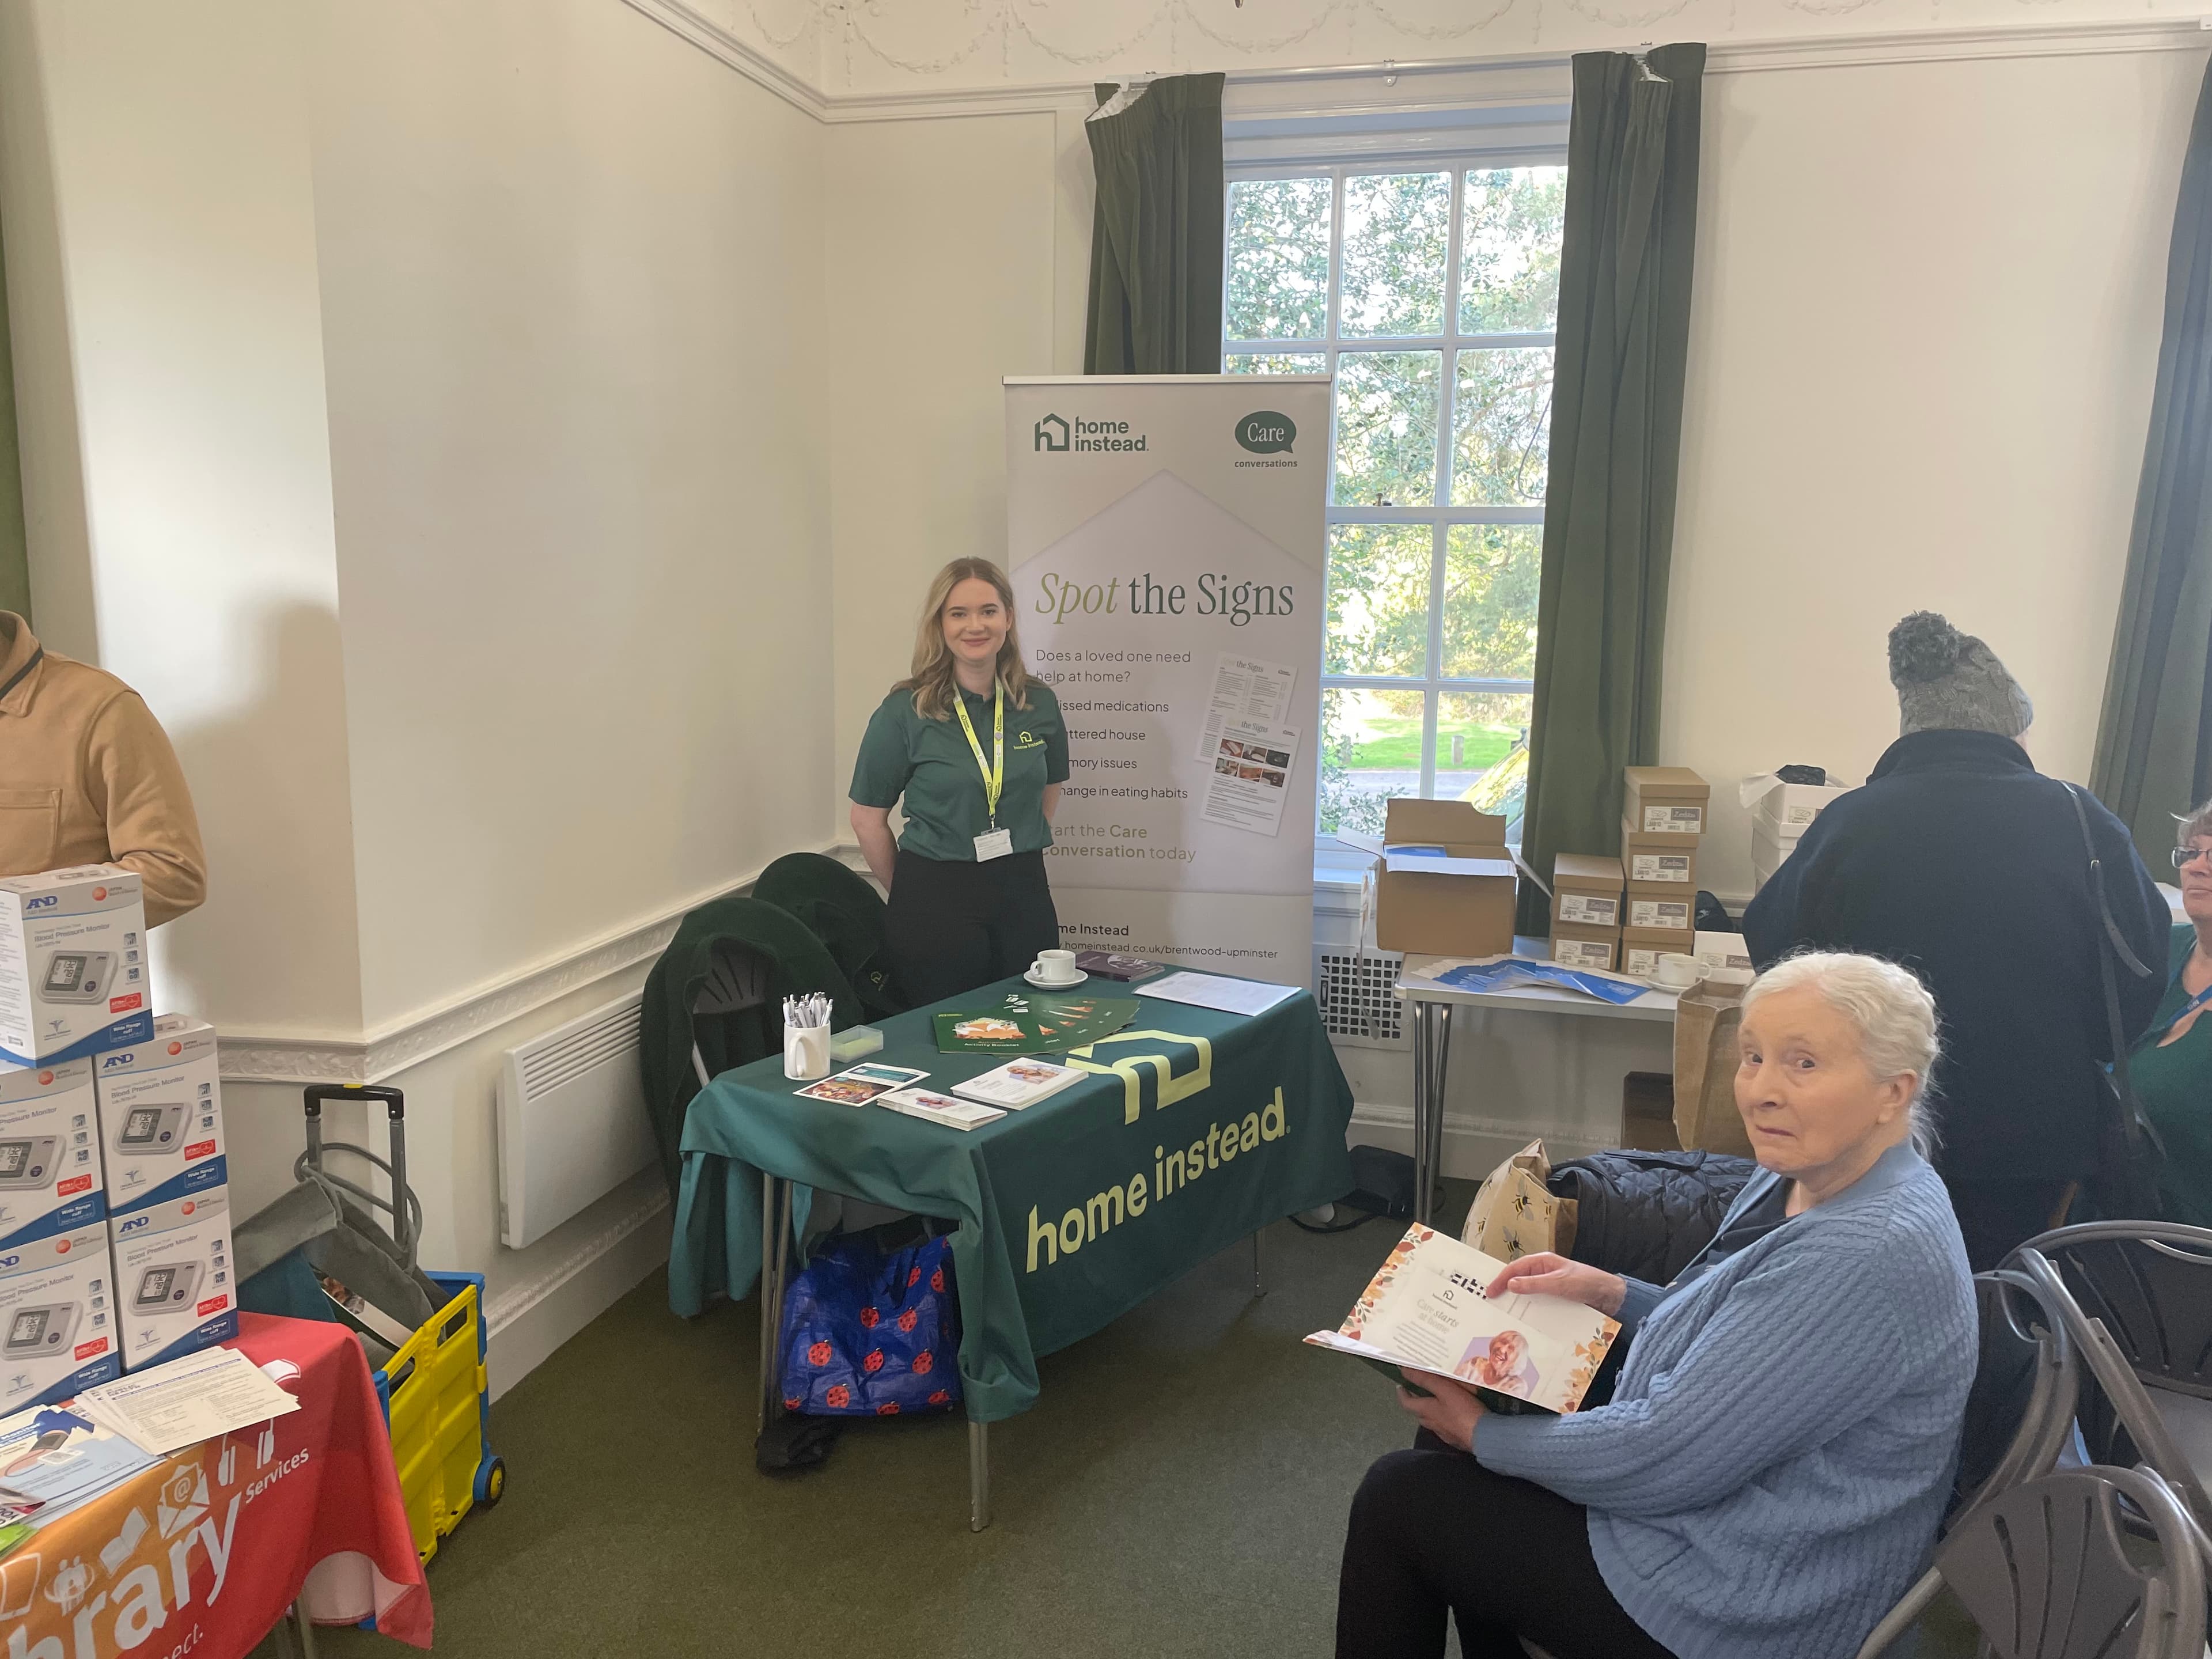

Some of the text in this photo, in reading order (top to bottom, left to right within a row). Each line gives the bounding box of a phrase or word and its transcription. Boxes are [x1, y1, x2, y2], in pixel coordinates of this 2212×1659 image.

[1075, 416, 1129, 434] home
[1247, 422, 1285, 442] Care
[1234, 459, 1298, 468] conversations
[1035, 573, 1294, 627] Spot the Signs
[1036, 649, 1191, 663] Does a loved one need
[1247, 662, 1264, 673] Signs
[1069, 672, 1081, 683] at
[1085, 671, 1131, 683] home?
[1057, 700, 1169, 713] issed medications
[1109, 729, 1146, 741] house
[1253, 724, 1269, 733] Signs
[1069, 758, 1137, 770] mory issues
[1060, 786, 1188, 800] hange in eating habits
[1080, 824, 1105, 837] the
[1110, 825, 1147, 838] Care
[1149, 847, 1196, 863] today
[26, 896, 58, 910] AND
[34, 934, 54, 942] Blood
[55, 927, 84, 938] Pressure
[86, 923, 111, 933] Monitor
[1080, 923, 1129, 936] Instead
[103, 1053, 134, 1069] AND
[111, 1089, 130, 1099] Blood
[132, 1083, 160, 1093] Pressure
[162, 1075, 185, 1086] Monitor
[0, 1107, 57, 1124] Pressure Monitor
[119, 1216, 149, 1233] AND
[1026, 1173, 1147, 1273] home
[127, 1253, 146, 1262] Blood
[147, 1243, 174, 1254] Pressure
[175, 1234, 198, 1245] Monitor
[0, 1255, 20, 1267] ND
[18, 1282, 48, 1295] Pressure
[49, 1274, 74, 1286] Monitor
[1434, 1309, 1459, 1328] starts
[246, 1448, 309, 1504] Services
